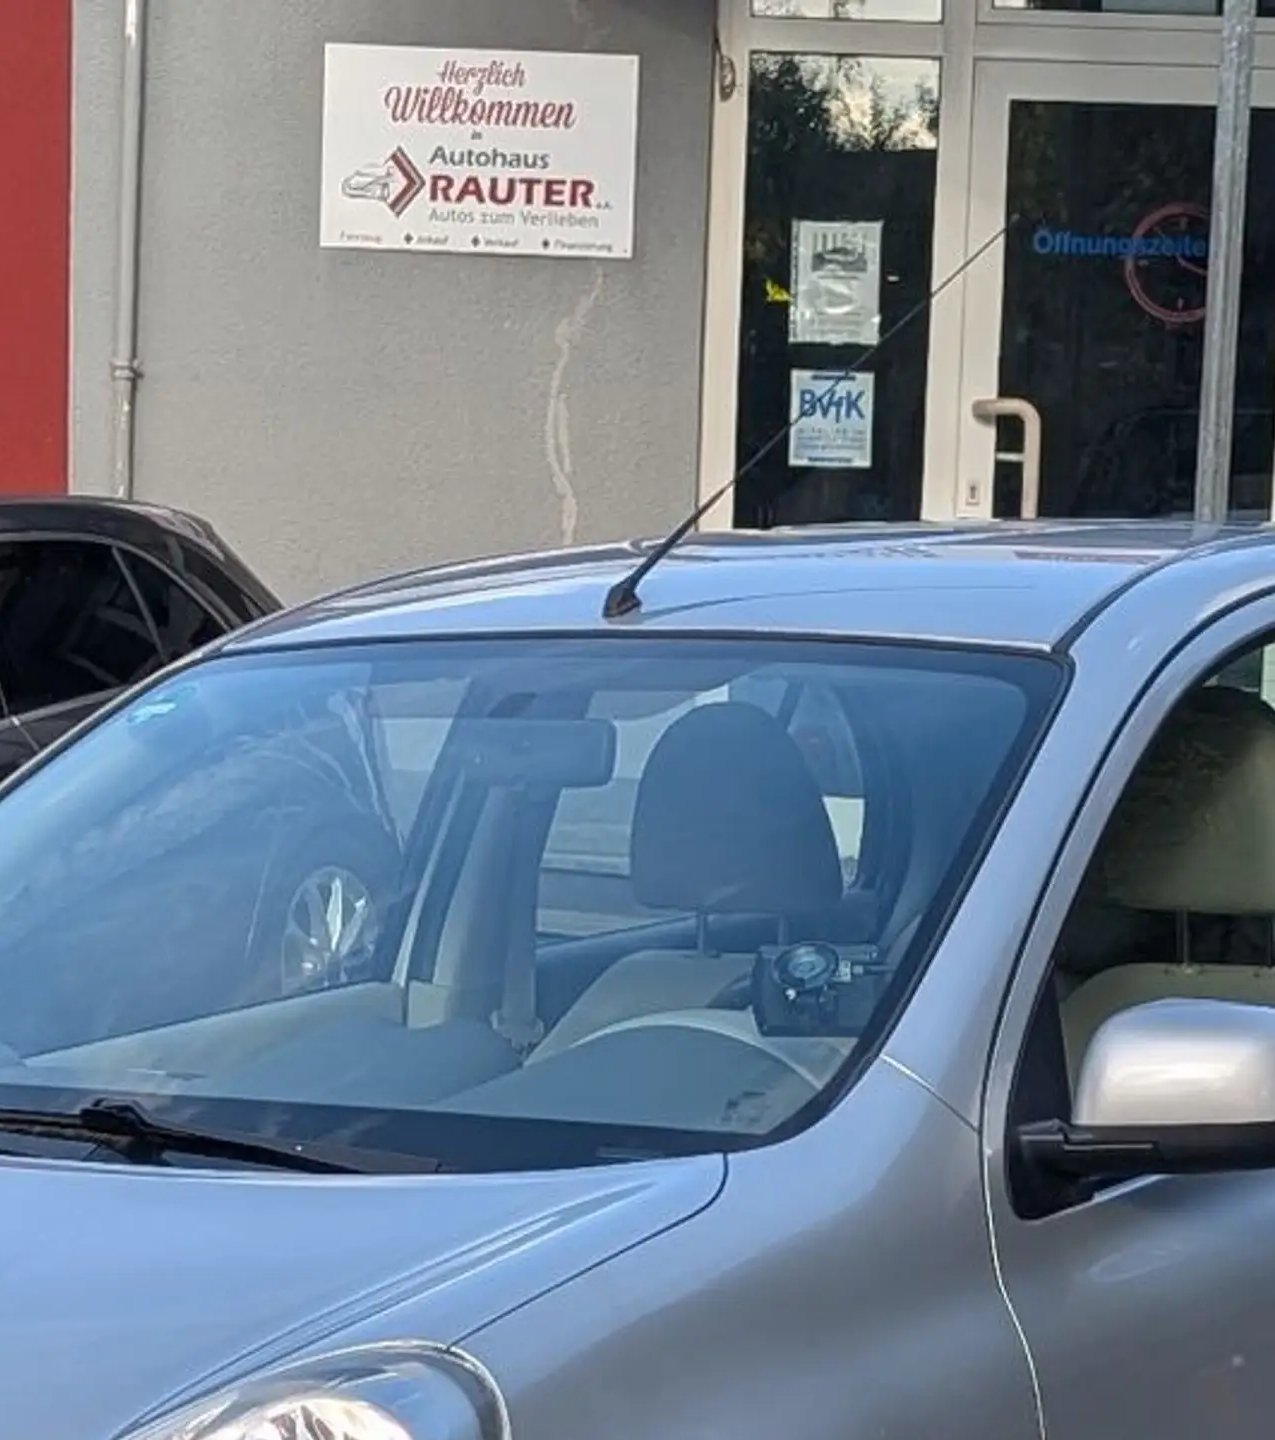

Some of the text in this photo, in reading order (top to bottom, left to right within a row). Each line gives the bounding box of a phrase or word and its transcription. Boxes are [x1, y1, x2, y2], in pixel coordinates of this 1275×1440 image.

[436, 60, 525, 95] Herzlich
[384, 86, 577, 130] Willkommen
[429, 145, 550, 169] Autohaus
[429, 174, 595, 209] RAUTER
[429, 209, 599, 229] Autos zum Verlieben
[1034, 226, 1208, 258] Öffnungszeite
